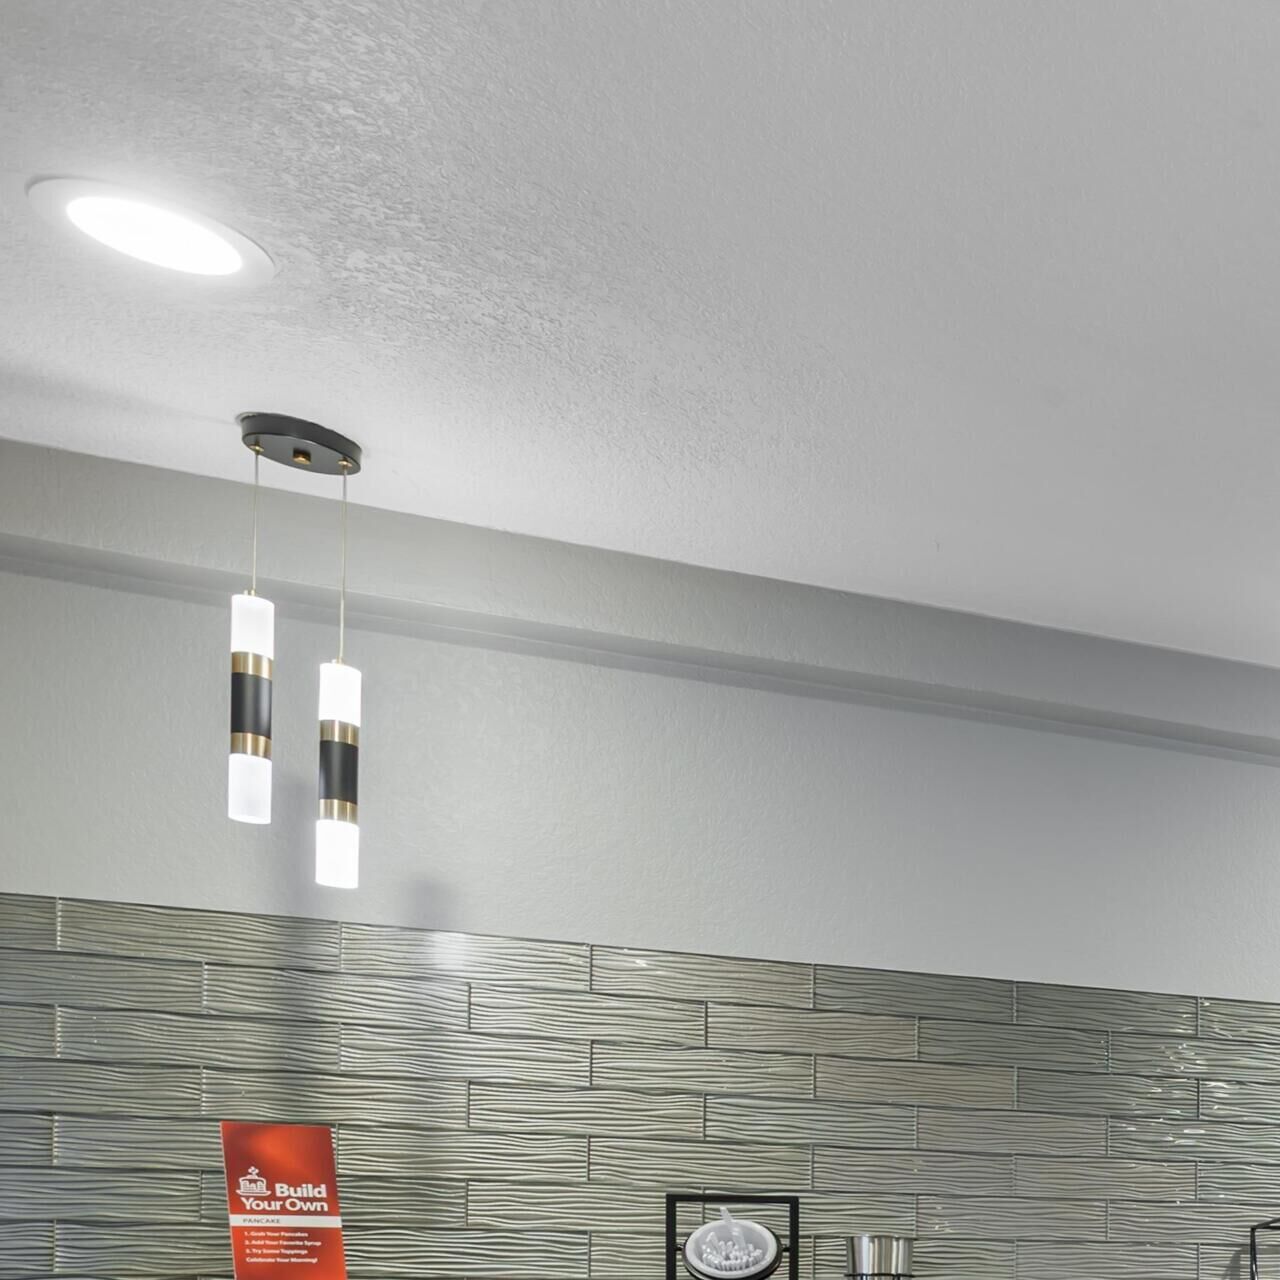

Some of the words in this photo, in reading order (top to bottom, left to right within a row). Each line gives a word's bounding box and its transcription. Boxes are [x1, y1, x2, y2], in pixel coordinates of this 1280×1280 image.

[275, 1183, 328, 1198] Build
[241, 1197, 284, 1211] Your
[285, 1198, 329, 1212] Own
